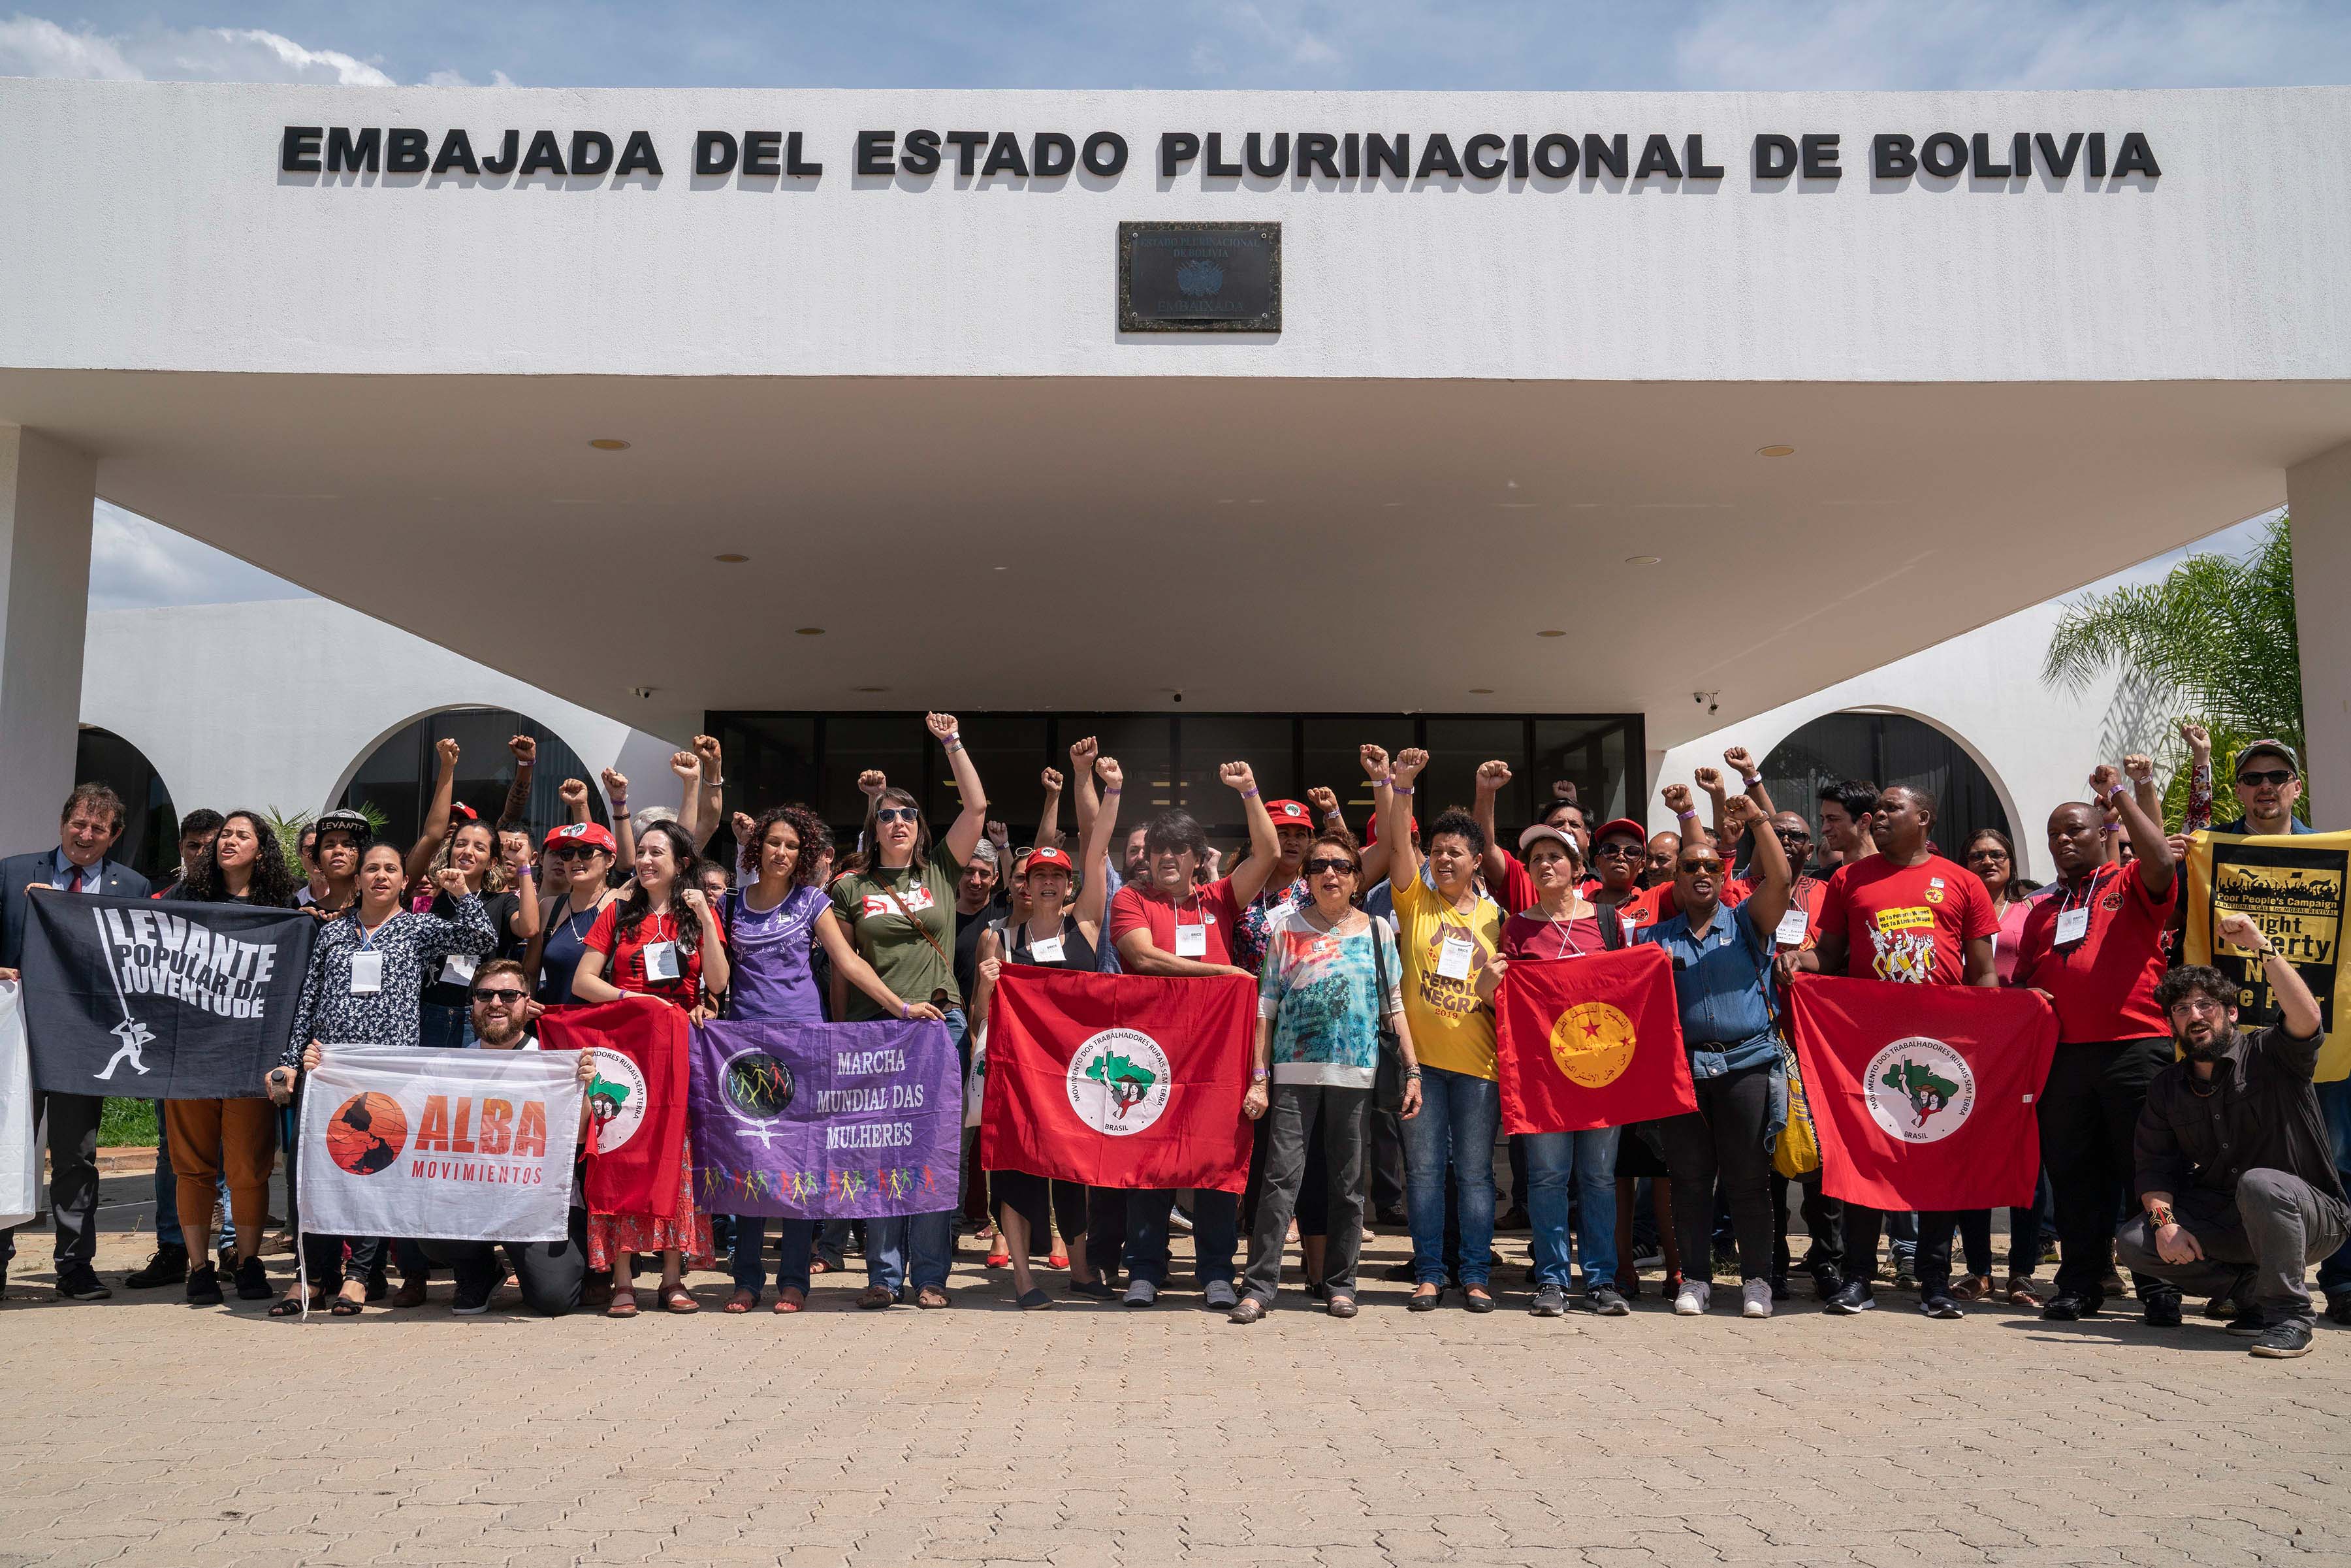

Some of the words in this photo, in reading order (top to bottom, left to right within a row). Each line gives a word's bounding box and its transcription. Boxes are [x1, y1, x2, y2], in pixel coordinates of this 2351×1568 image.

[282, 127, 664, 175] EMBAJADA
[695, 129, 823, 176] DEL
[857, 129, 1129, 177] ESTADO
[1161, 132, 1725, 179] PLURINACIONAL
[1755, 133, 1843, 178] DE
[1874, 132, 2162, 178] BOLIVIA
[1139, 238, 1177, 247] ESTADO
[1180, 237, 1259, 247] PLURINACIONAL
[1173, 249, 1187, 257] DE
[1189, 249, 1228, 258] BOLIVIA
[1157, 300, 1244, 312] EMBAIXADA
[322, 821, 364, 831] LEVANTE
[2217, 893, 2240, 903] Poor
[2243, 895, 2284, 906] People's
[2287, 898, 2337, 910] Campaign
[104, 908, 278, 982] LEVANTE
[2218, 935, 2331, 962] erty
[114, 944, 230, 995] POPULAR
[234, 979, 262, 1000] DA
[1422, 970, 1478, 997] PEROL
[121, 967, 265, 1019] JUVENTUDE
[1420, 983, 1482, 1014] NEGRA
[1435, 1008, 1458, 1019] 2019
[1081, 1044, 1093, 1057] DOS
[1093, 1032, 1150, 1046] TRABALHADORES
[837, 1049, 906, 1075] MARCHA
[1149, 1044, 1166, 1068] RURAIS
[619, 1058, 639, 1080] RURAIS
[1071, 1058, 1083, 1102] MOVIMENTO
[1868, 1064, 1879, 1110] MOVIMENTO
[1877, 1053, 1891, 1064] DOS
[1889, 1041, 1951, 1056] TRABALHADORES
[1949, 1054, 1969, 1078] RURAIS
[1959, 1095, 1972, 1115] TERRA
[635, 1080, 643, 1095] SEM
[816, 1087, 889, 1113] MUNDIAL
[893, 1084, 923, 1108] DAS
[1157, 1085, 1168, 1106] TERRA
[633, 1096, 644, 1119] TERRA
[413, 1095, 547, 1157] ALBA
[825, 1122, 912, 1149] MULHERES
[411, 1160, 543, 1185] MOVIMIENTOS
